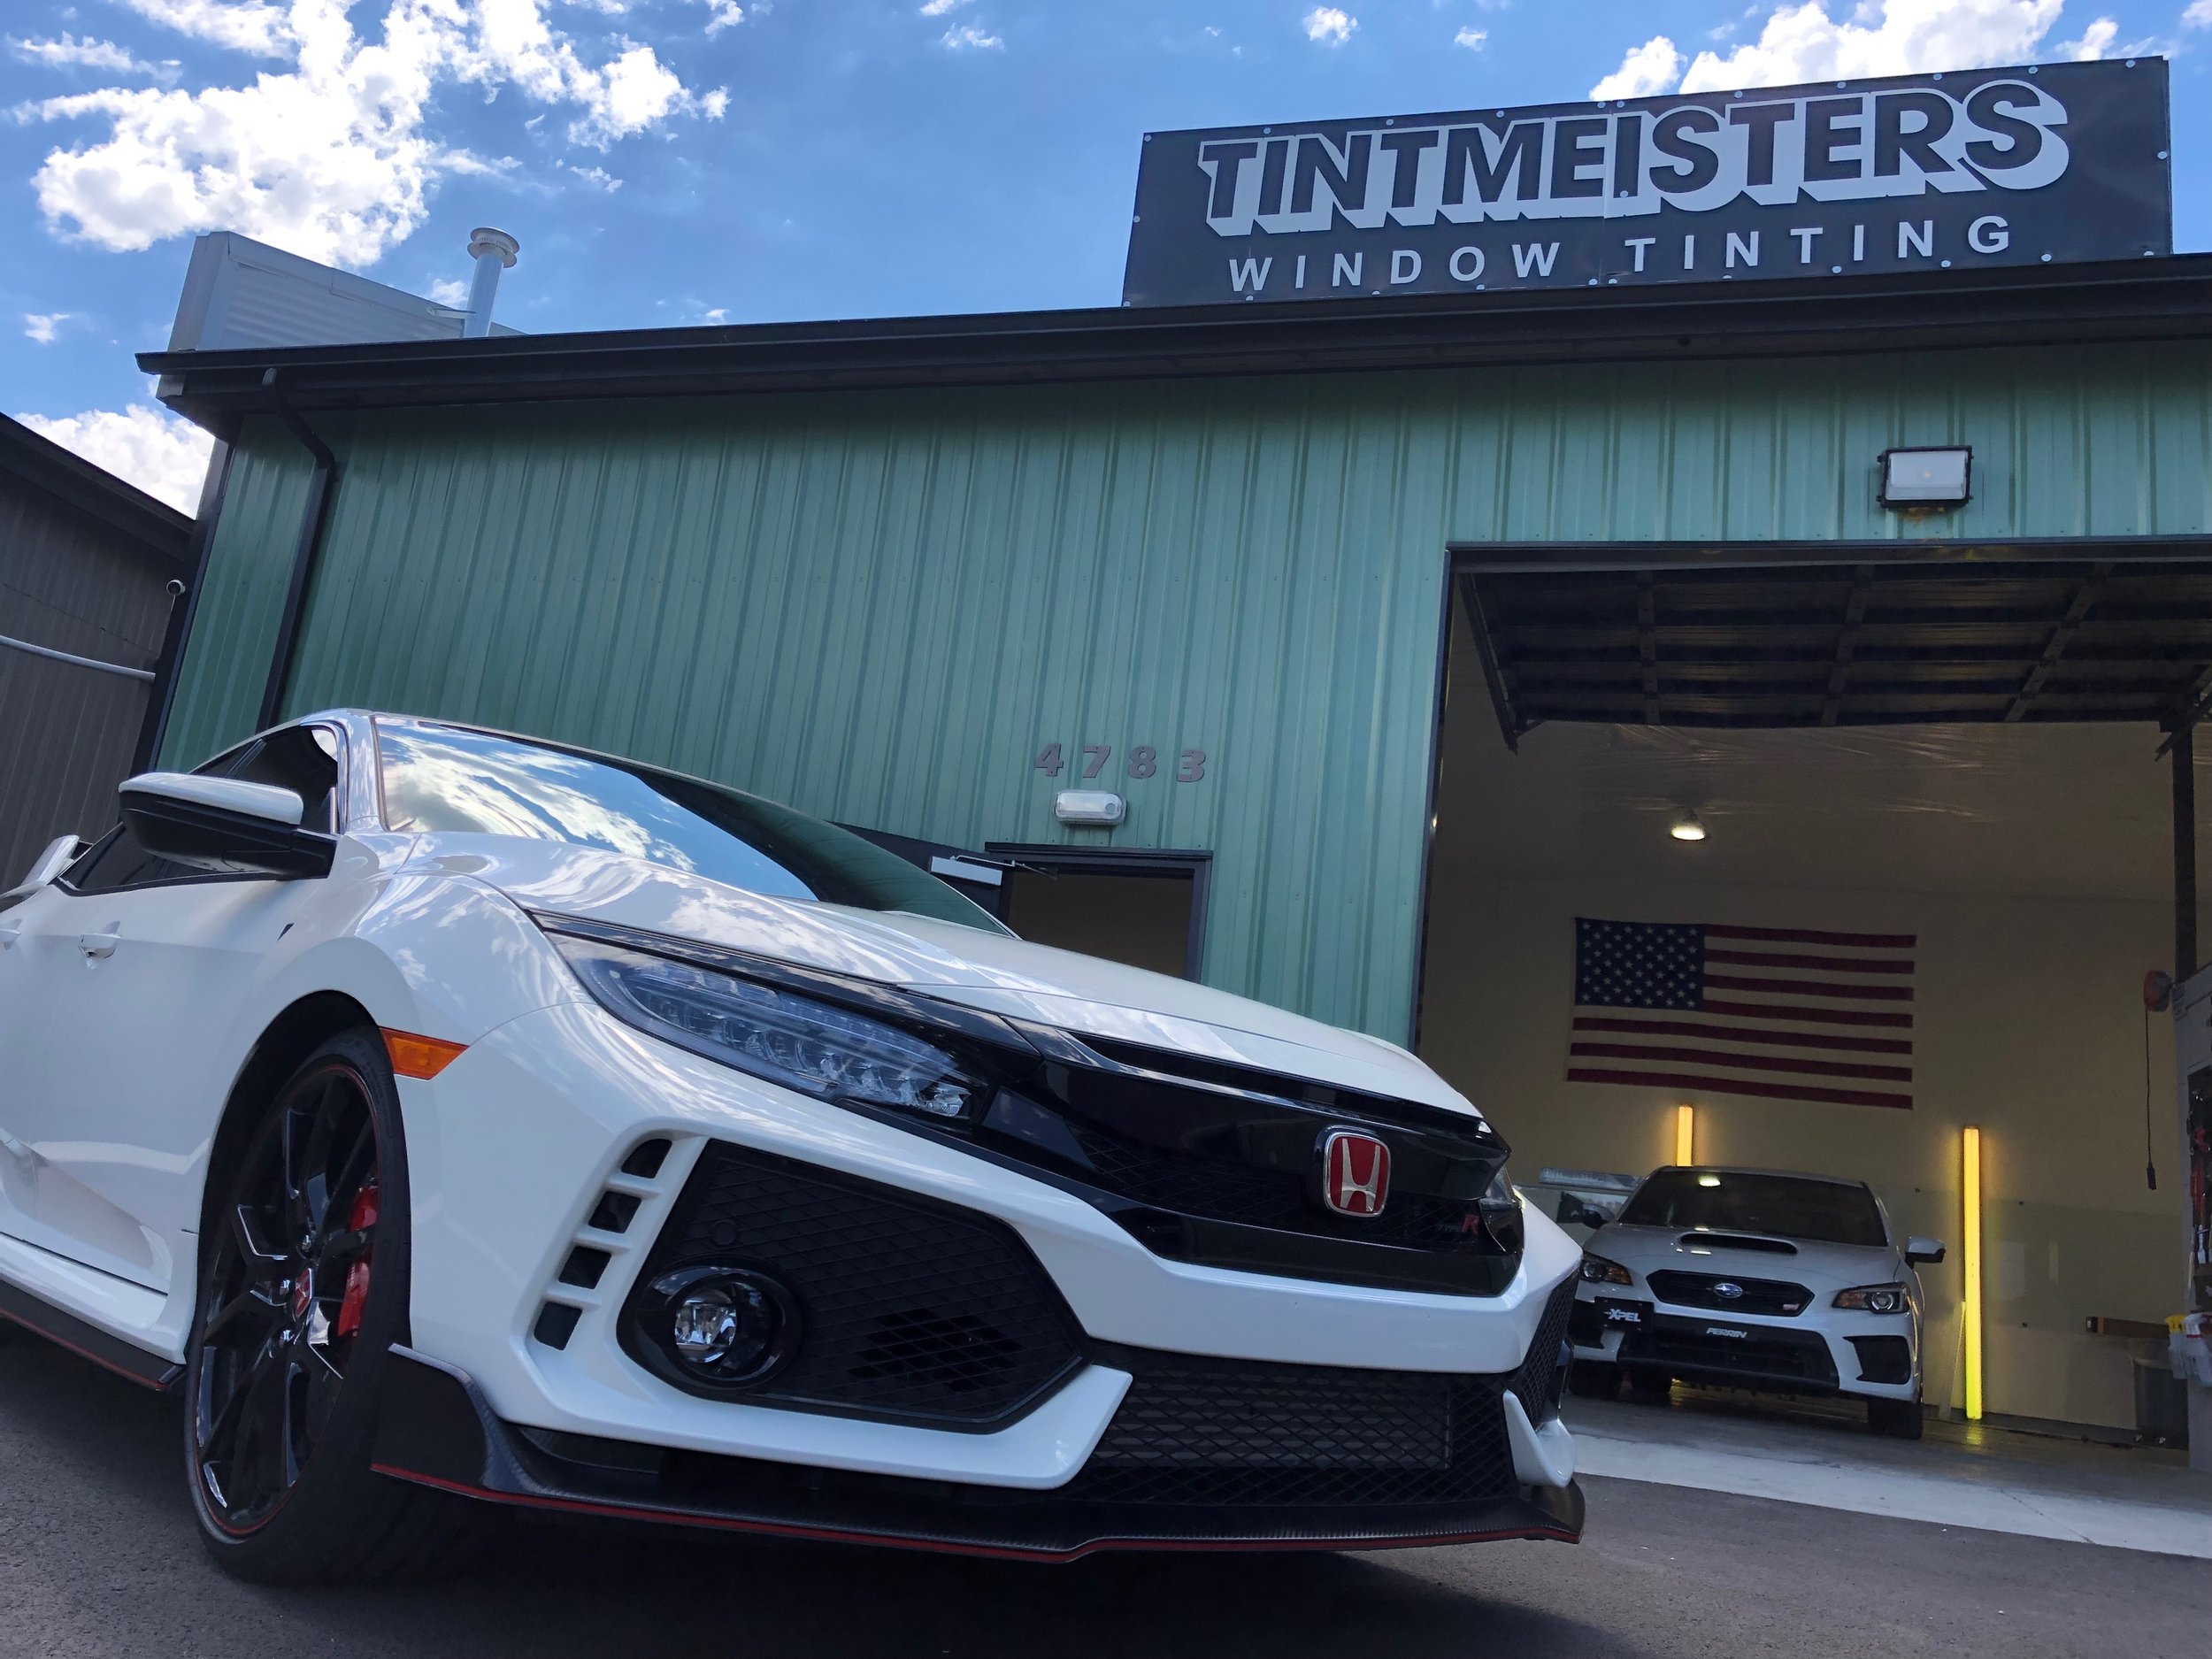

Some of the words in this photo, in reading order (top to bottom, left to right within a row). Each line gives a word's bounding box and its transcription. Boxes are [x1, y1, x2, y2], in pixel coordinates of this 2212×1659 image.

[1198, 80, 2069, 236] TINTMEISTERS
[1229, 242, 1560, 292] WINDOW
[1624, 216, 2008, 272] TINTING
[1033, 743, 1206, 782] 4783
[1606, 1308, 1641, 1323] XPEL
